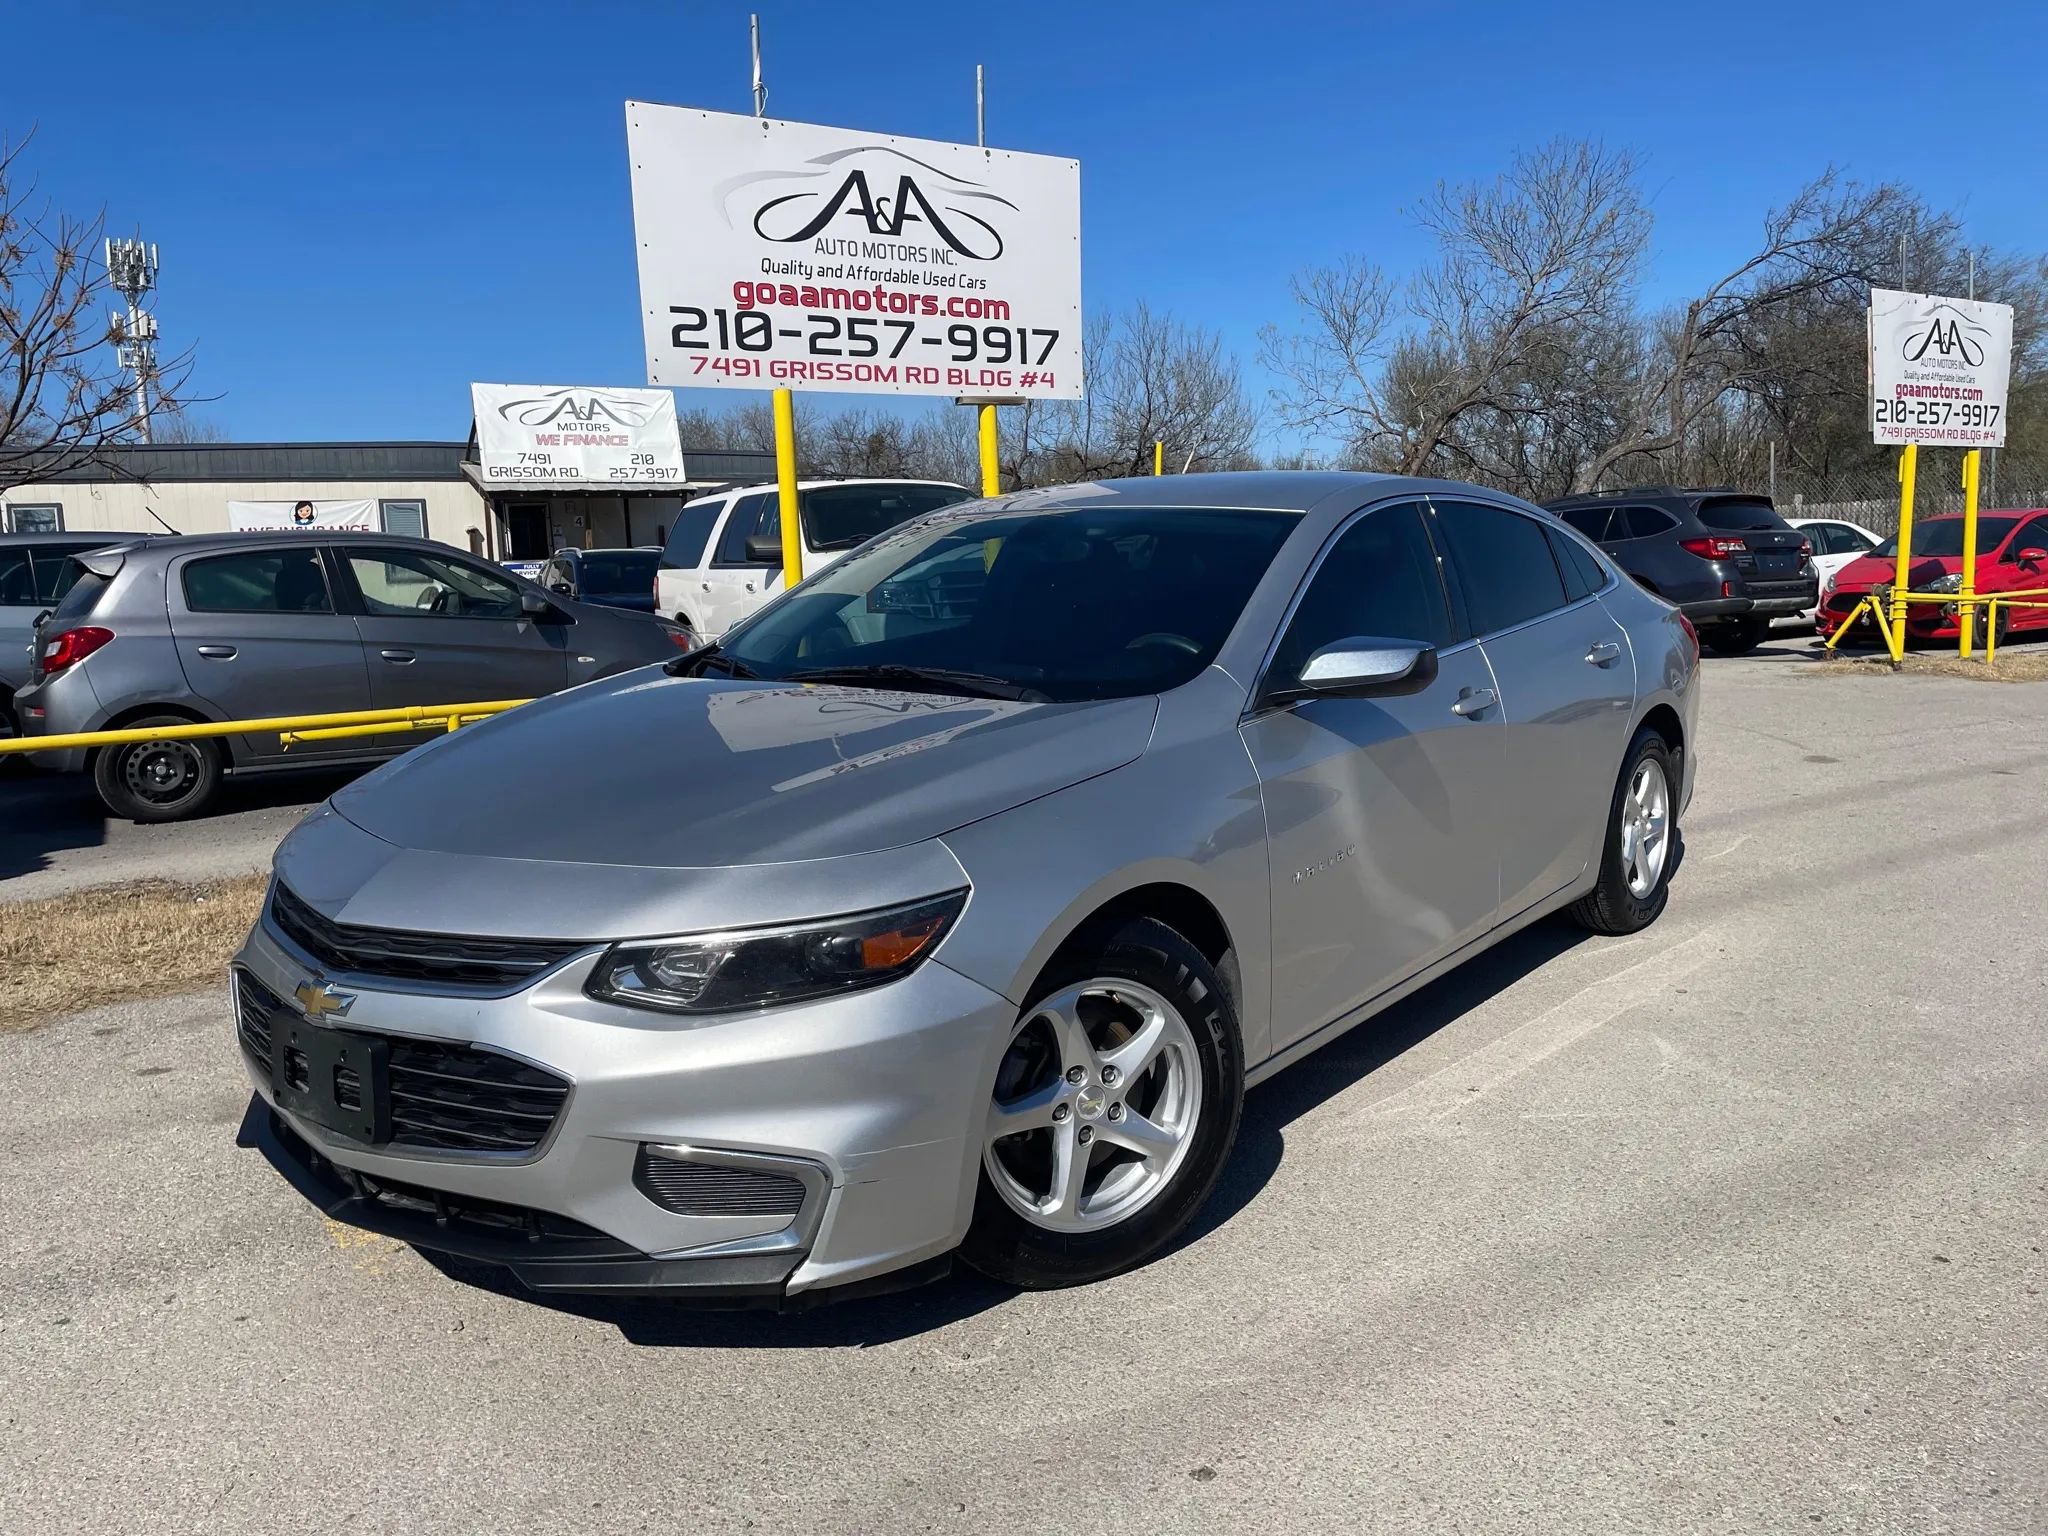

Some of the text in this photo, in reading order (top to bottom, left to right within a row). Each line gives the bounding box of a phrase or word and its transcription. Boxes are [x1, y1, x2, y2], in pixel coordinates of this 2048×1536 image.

[814, 237, 958, 266] AUTO MOTORS INC.
[761, 257, 987, 290] Quality and Affordable Used Cars
[733, 280, 1010, 320] goaamotors.com
[669, 305, 1060, 366] 210-257-9917
[1920, 357, 1936, 368] AUTO
[1937, 358, 1958, 370] MOTORS
[689, 356, 1055, 389] 7491 GRISSOM RD BLDG #4
[1903, 369, 1920, 382] Quality
[1920, 372, 1931, 381] and
[1930, 372, 1955, 383] Affordable
[1895, 382, 1983, 401] goaamotors.com
[1875, 398, 2000, 427] 210-257-9917
[557, 422, 611, 432] MOTORS
[1880, 426, 1996, 441] 7491 GRISSOM RD BLDG #4
[535, 433, 629, 447] WE FINANCE
[517, 452, 552, 465] 7491
[630, 453, 655, 466] 210
[488, 466, 583, 478] GRISSOM RD.
[608, 467, 679, 479] 257-9917
[575, 516, 583, 527] 4
